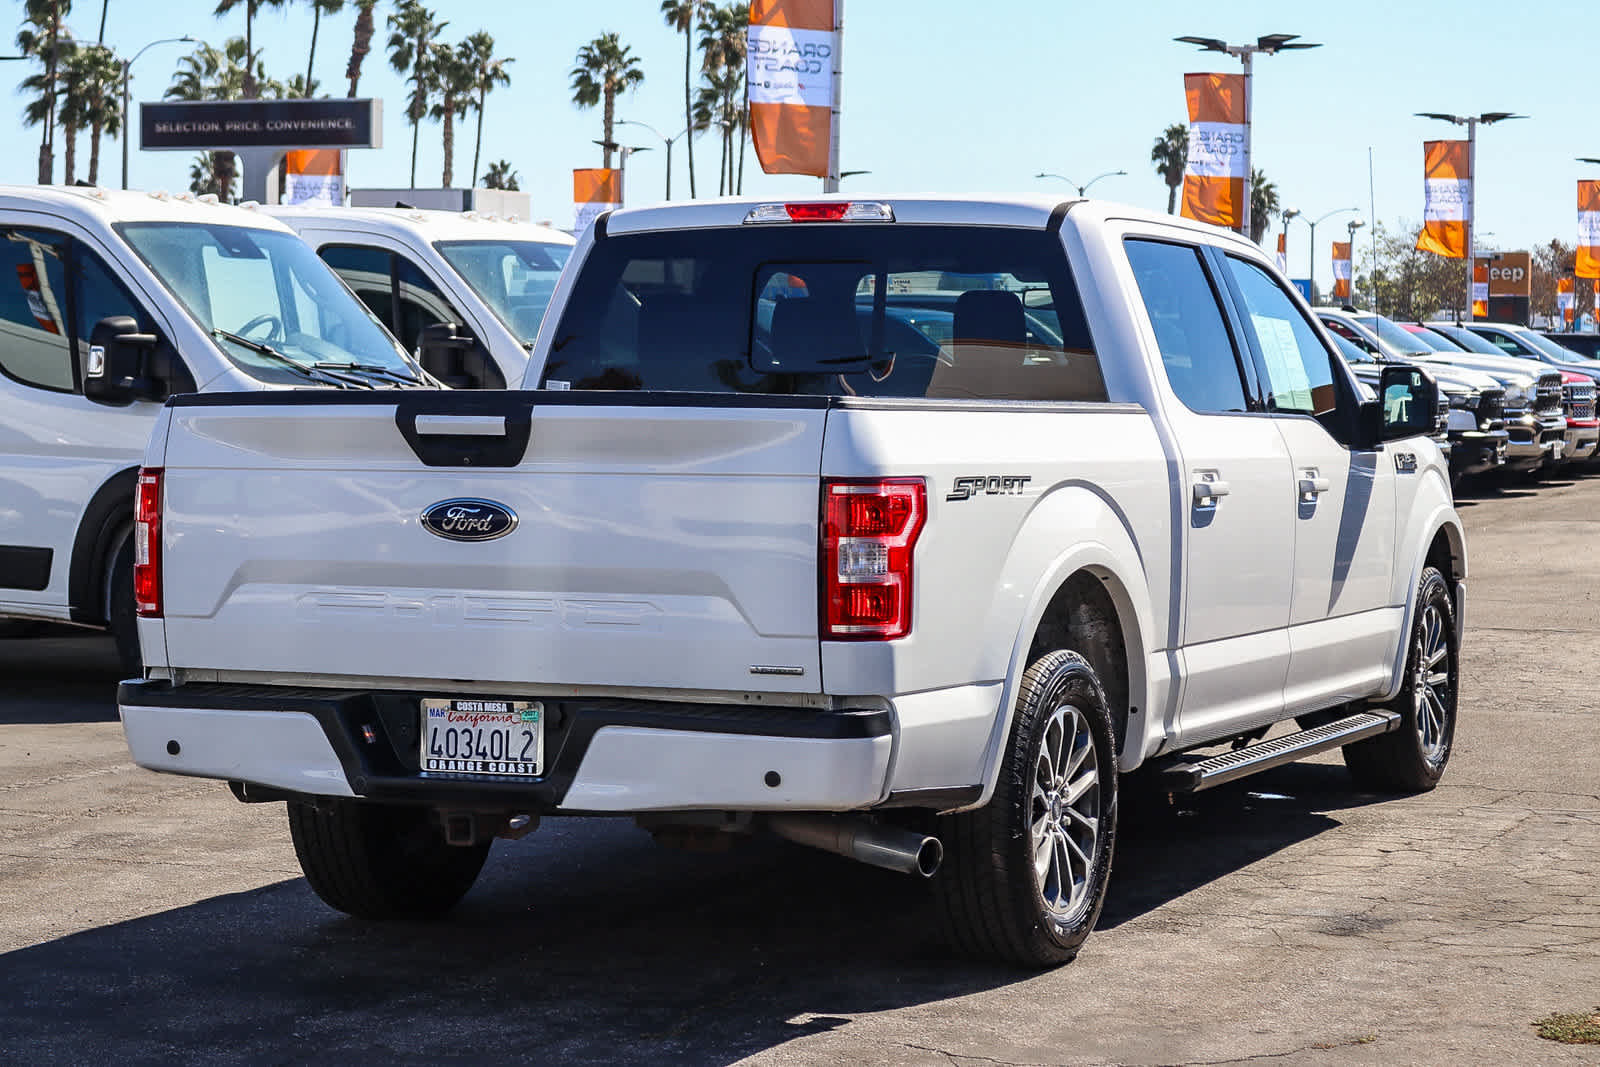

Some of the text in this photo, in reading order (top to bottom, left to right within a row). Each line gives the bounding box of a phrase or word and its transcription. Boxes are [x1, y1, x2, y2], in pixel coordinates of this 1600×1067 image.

[154, 118, 356, 133] SELECTION. PRICE. CONVENIENCE.
[1490, 267, 1524, 283] eep
[945, 476, 1031, 502] SPORT
[442, 507, 493, 531] Ford
[429, 708, 446, 718] MAR
[456, 701, 508, 712] COSTA MESA
[447, 711, 520, 727] California
[430, 727, 534, 762] 40340L2
[429, 760, 534, 774] ORANGE COAST
